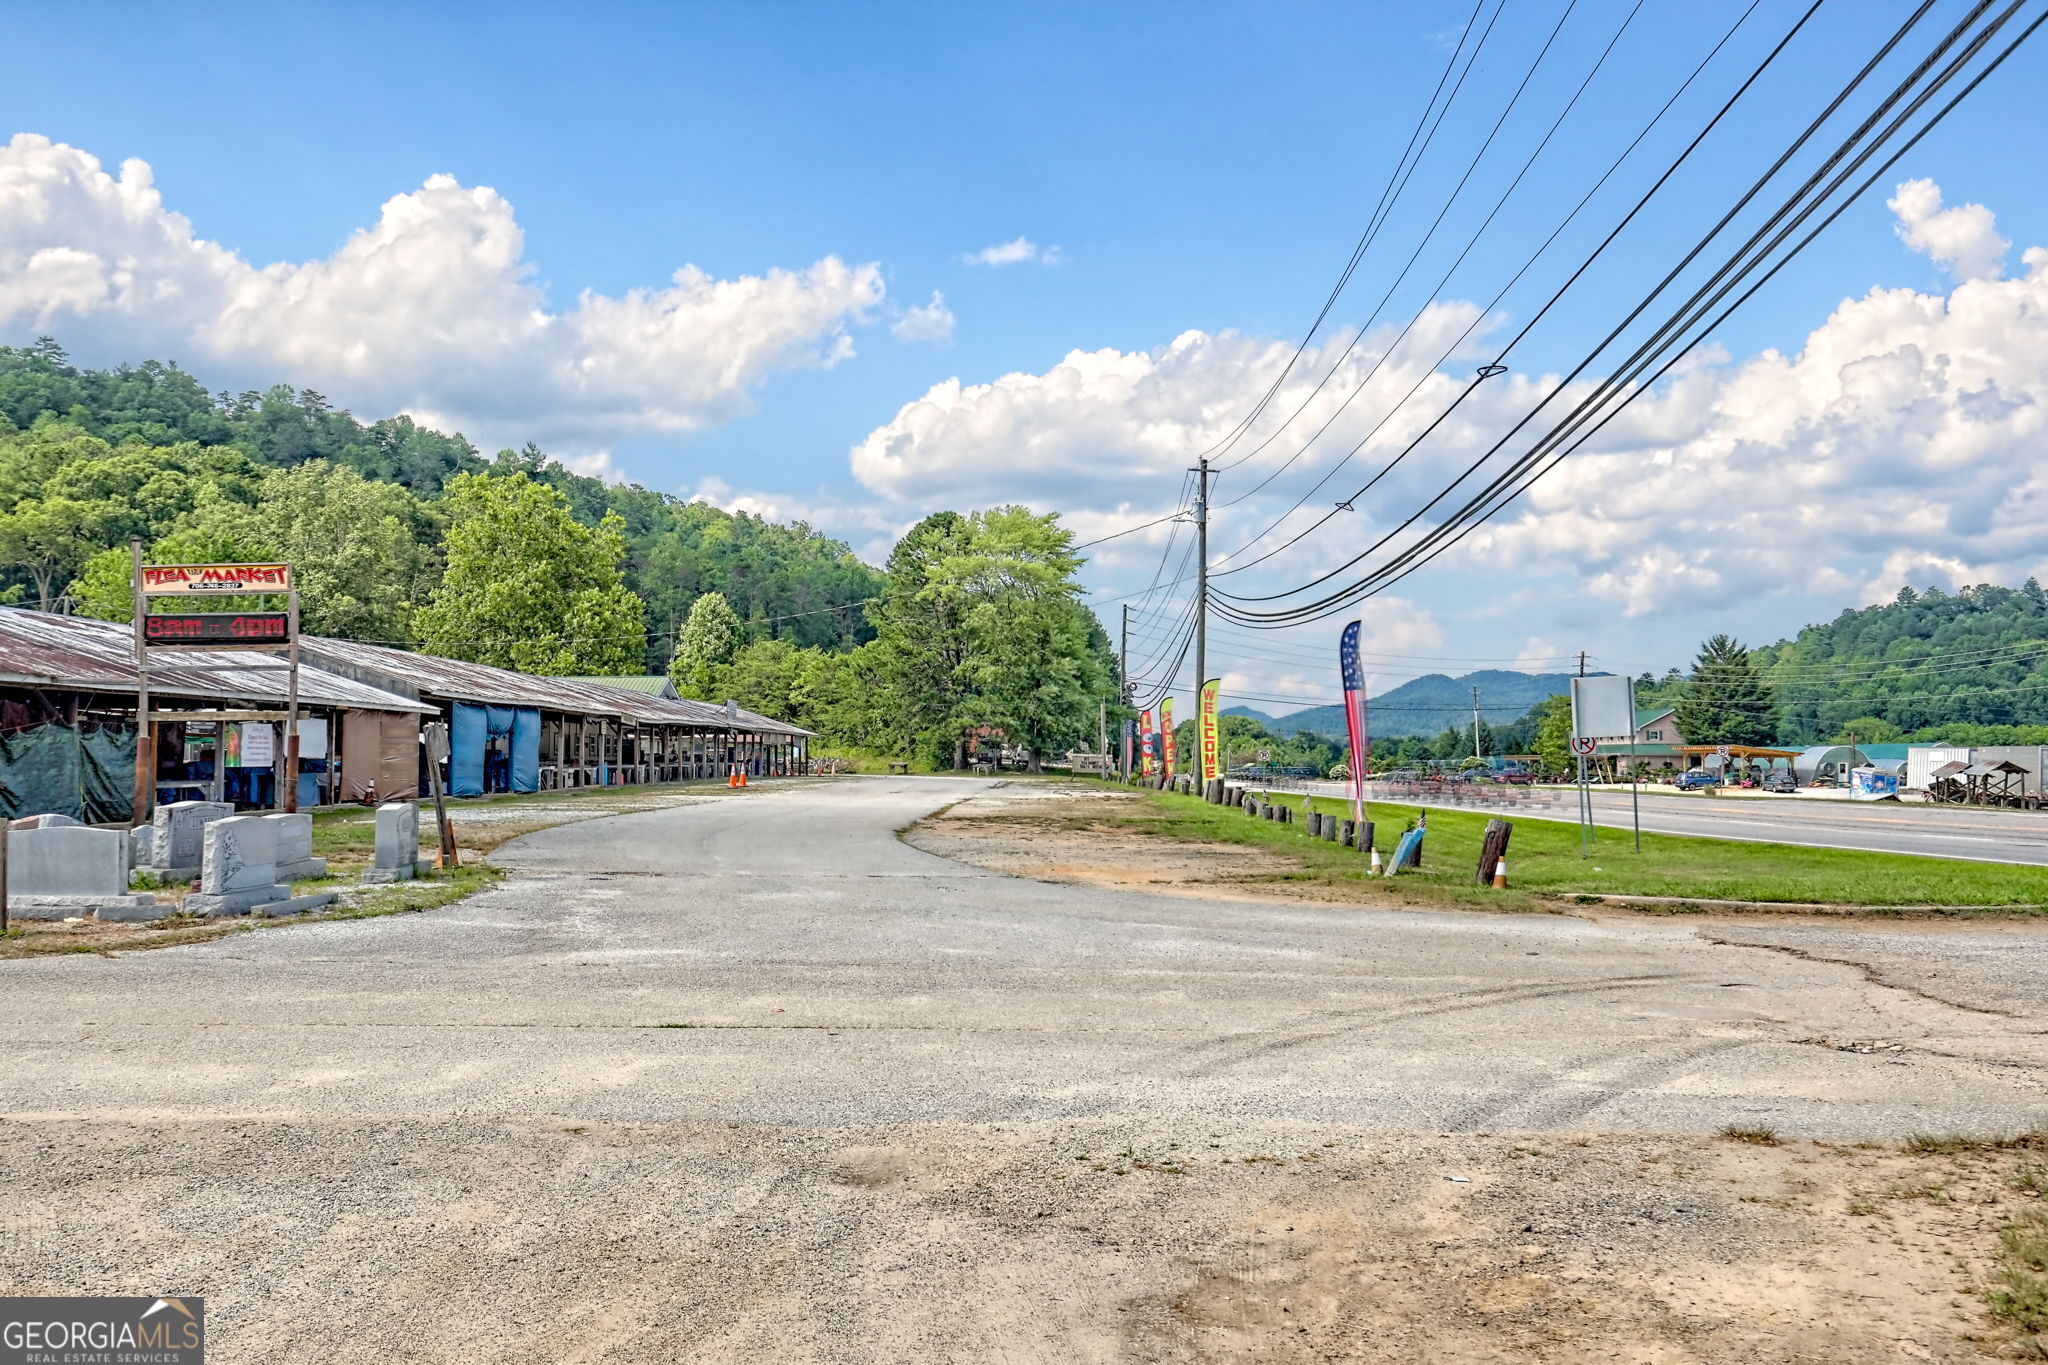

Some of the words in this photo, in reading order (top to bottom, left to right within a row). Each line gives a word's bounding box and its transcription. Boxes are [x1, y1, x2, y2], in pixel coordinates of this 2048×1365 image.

[144, 568, 190, 585] FLEA
[200, 566, 287, 584] MARKET
[146, 617, 202, 637] 8am
[229, 616, 284, 637] 4pm
[1165, 720, 1174, 775] OPEN
[1203, 688, 1215, 778] WELCOME
